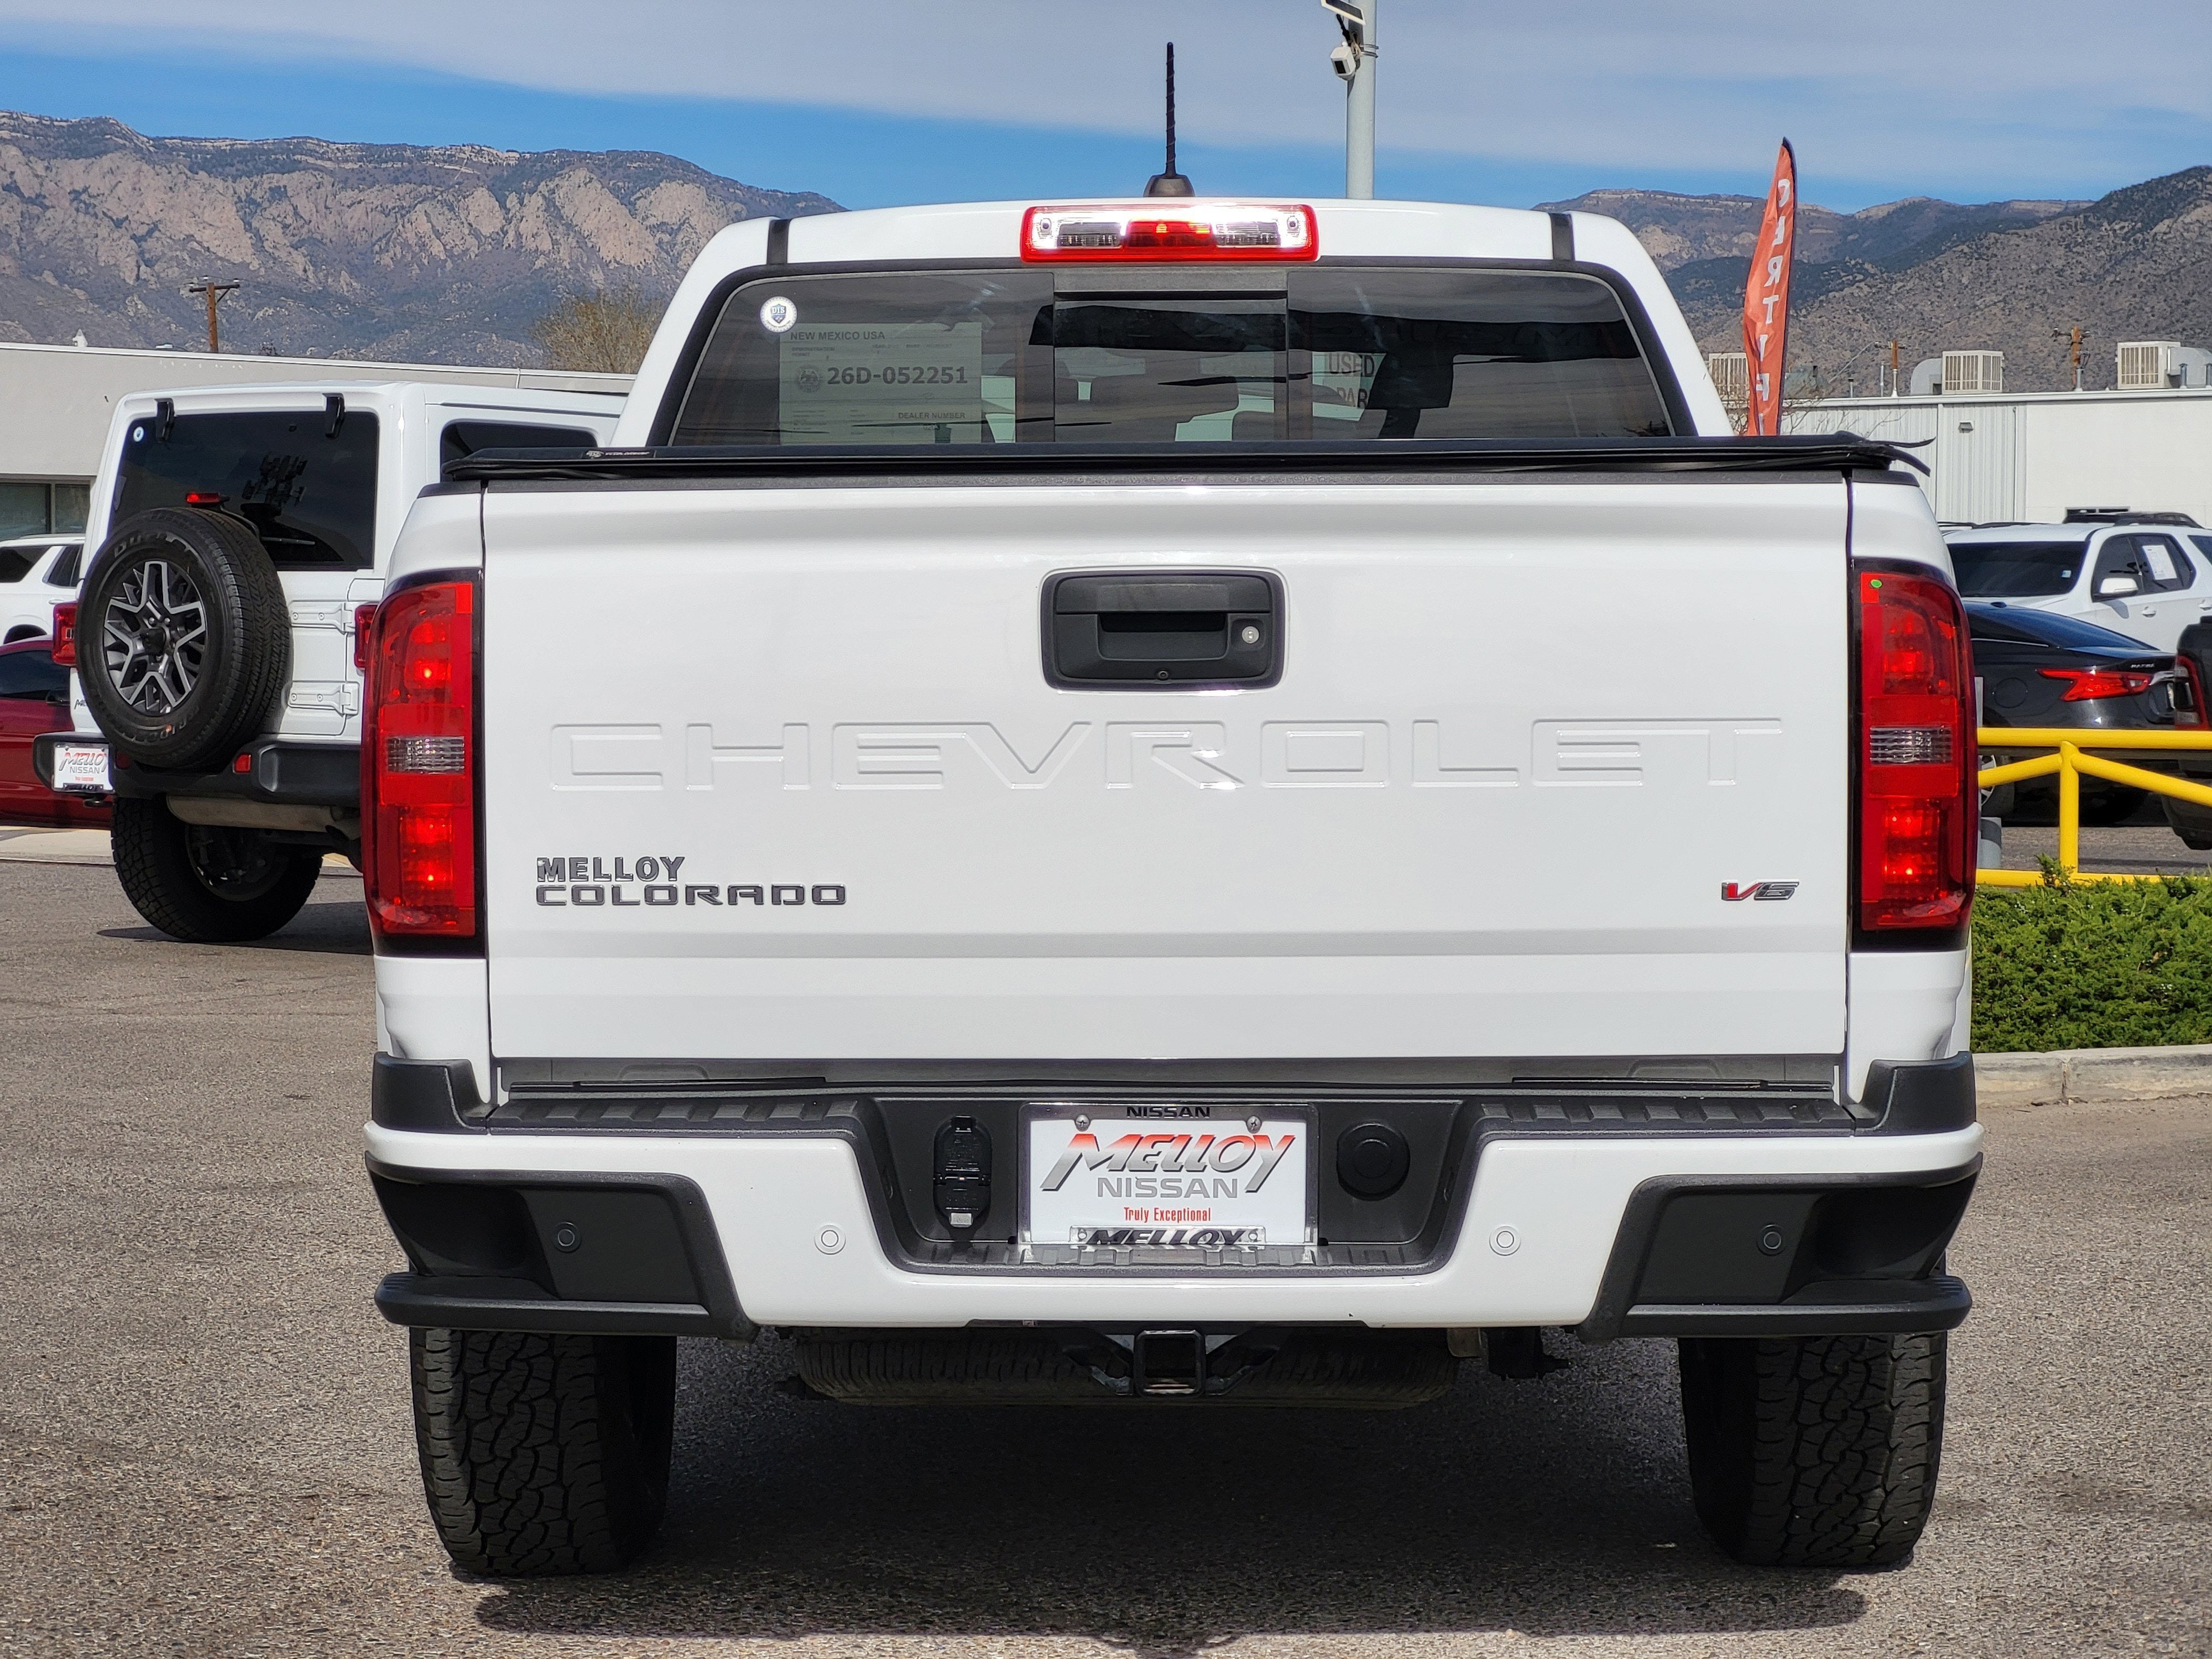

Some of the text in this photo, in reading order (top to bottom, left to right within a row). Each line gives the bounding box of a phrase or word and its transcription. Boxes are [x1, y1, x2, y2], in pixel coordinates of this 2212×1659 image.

[790, 331, 885, 340] NEW MEXICO USA
[827, 366, 968, 385] 26D-052251
[550, 718, 1782, 790] CHEVROLET
[536, 856, 685, 883] MELLOY
[535, 884, 847, 906] COLORADO
[1721, 881, 1800, 901] V6
[1126, 1105, 1211, 1118] NISSAN
[1039, 1133, 1296, 1193] MELLOY
[1097, 1176, 1238, 1199] NISSAN
[1124, 1207, 1212, 1223] Truly Exceptional
[1086, 1229, 1247, 1245] MELLOY
